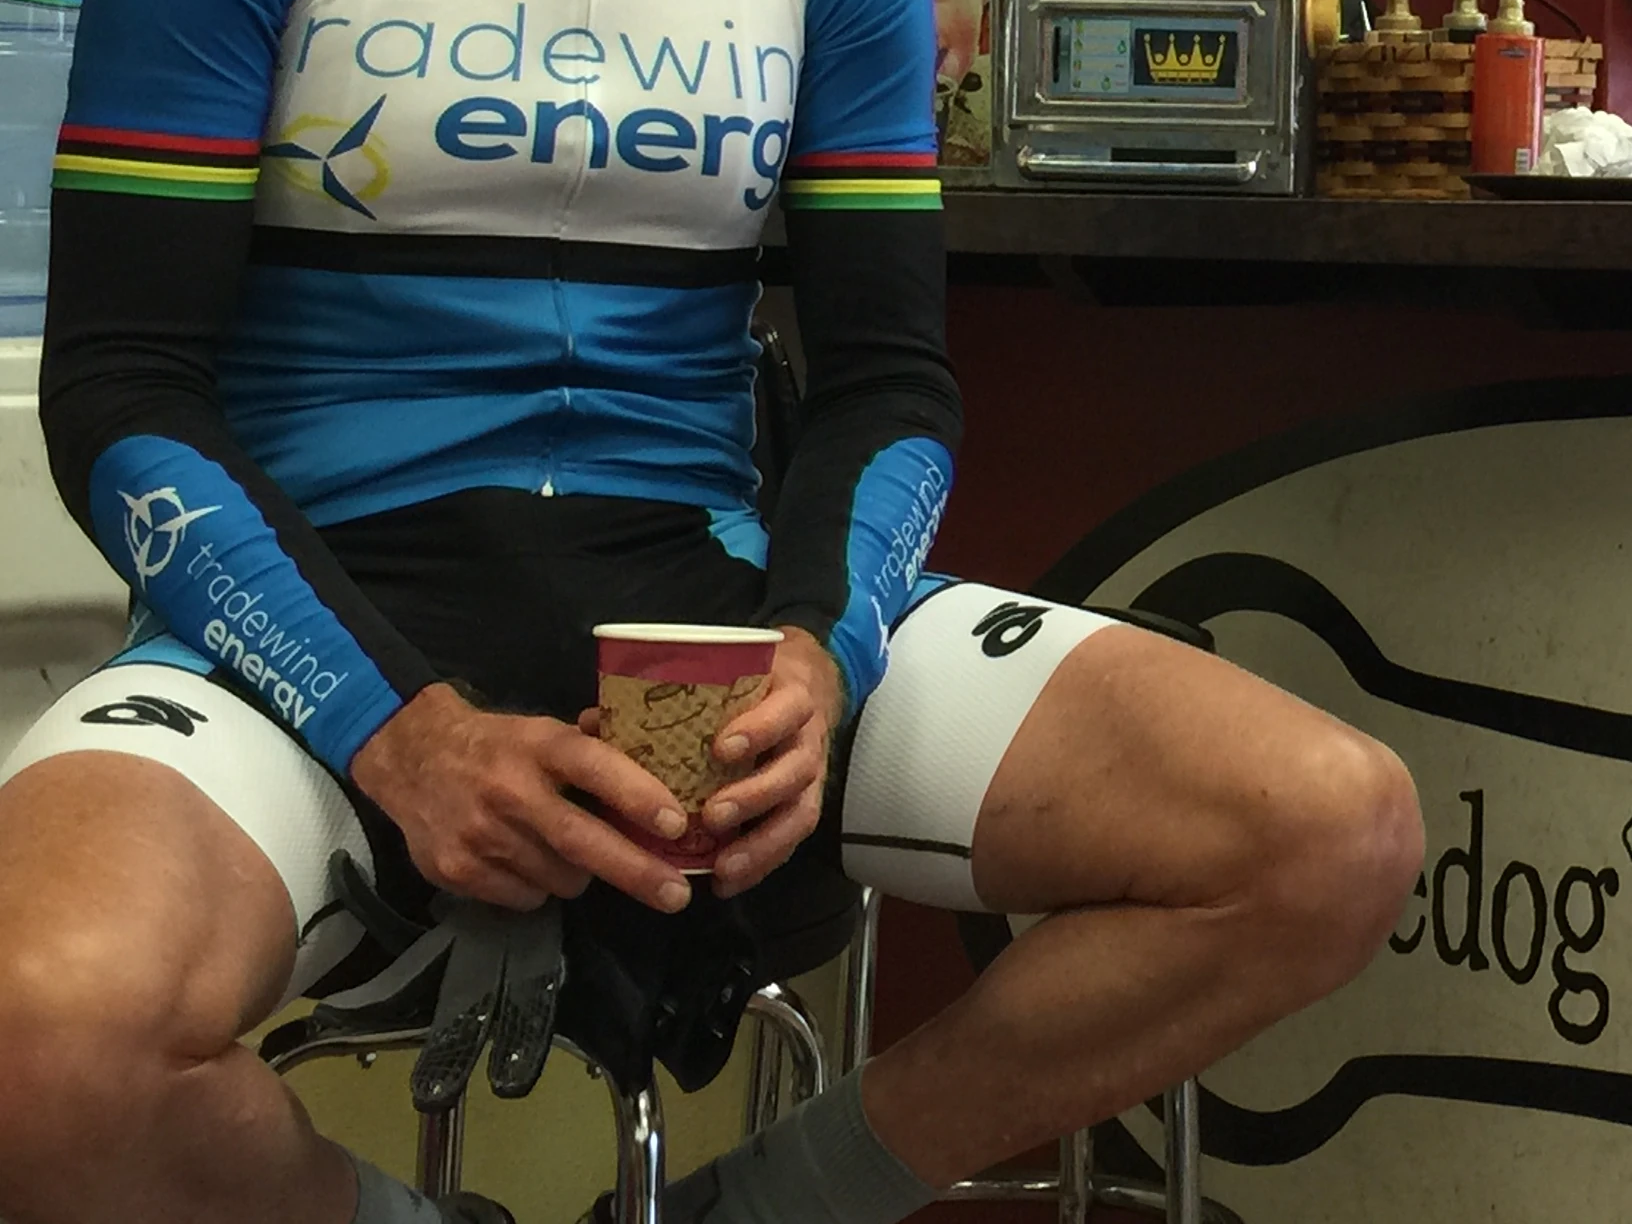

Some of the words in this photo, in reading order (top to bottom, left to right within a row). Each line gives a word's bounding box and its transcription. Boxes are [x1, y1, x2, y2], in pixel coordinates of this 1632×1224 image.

[295, 2, 798, 104] radewin
[433, 93, 793, 212] energ
[184, 541, 349, 703] tradewind
[203, 617, 317, 731] energy
